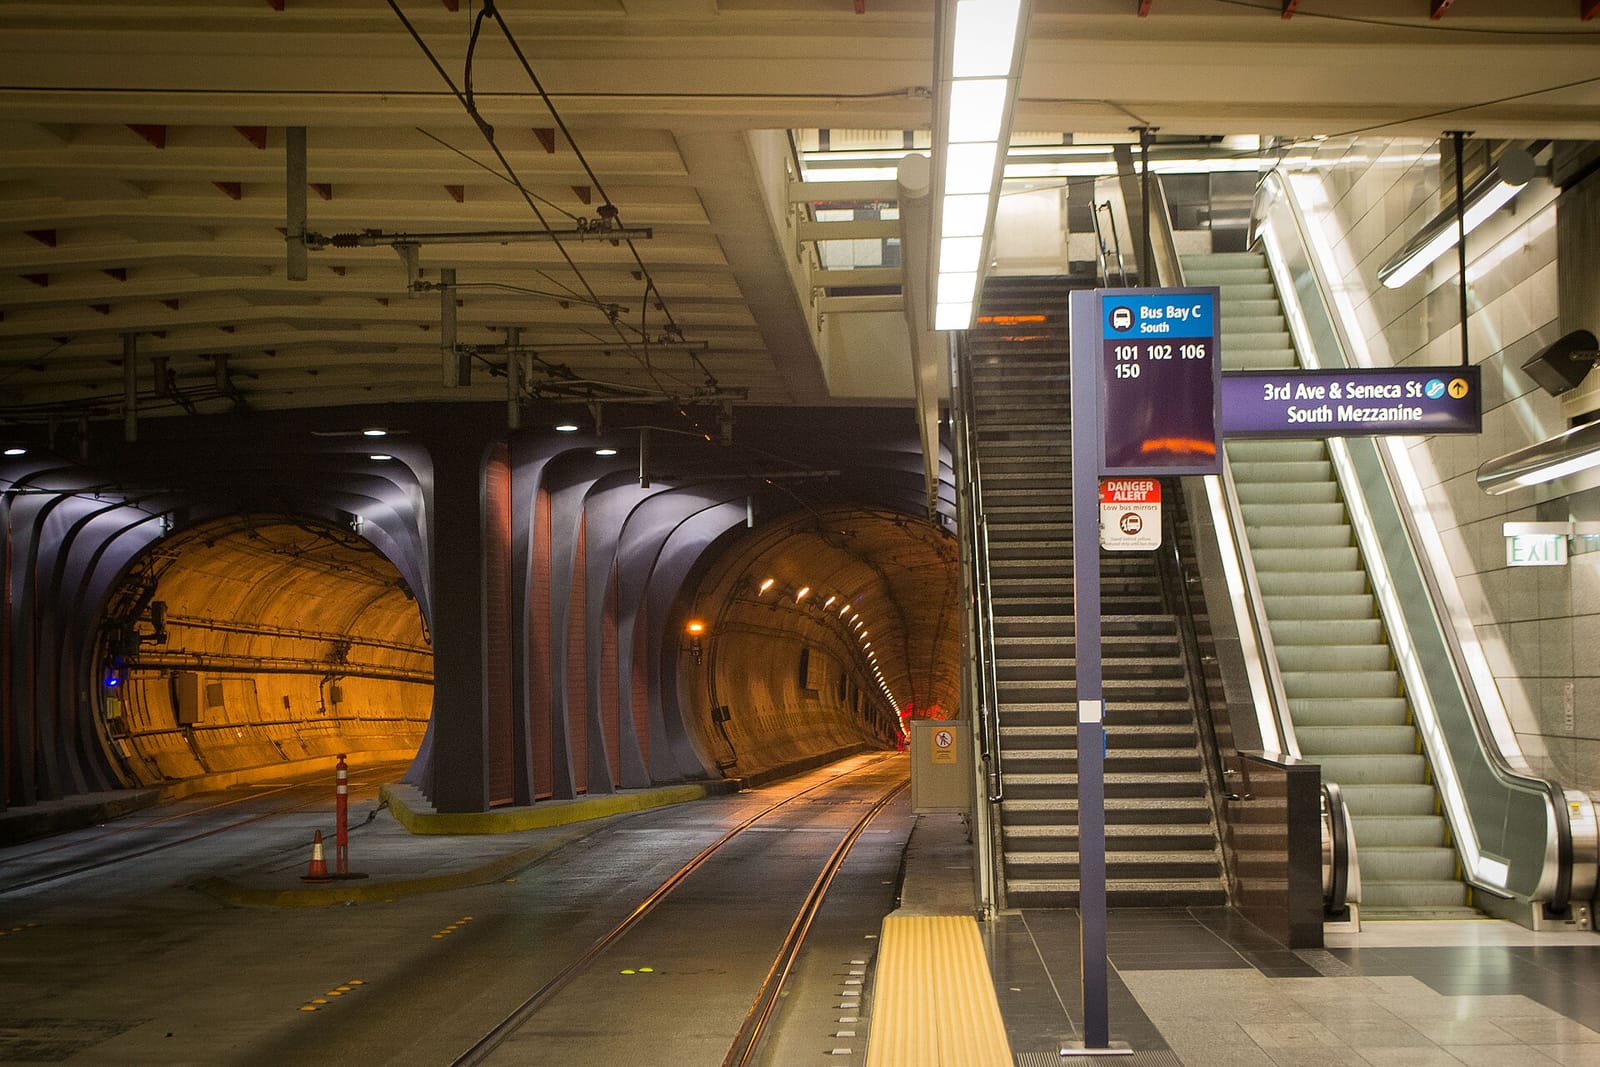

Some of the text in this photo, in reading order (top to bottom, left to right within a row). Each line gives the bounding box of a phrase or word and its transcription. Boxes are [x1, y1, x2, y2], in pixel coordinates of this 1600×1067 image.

[1140, 304, 1202, 321] Bus Bay C
[1140, 321, 1169, 333] South
[1114, 344, 1205, 360] 101 102 106
[1114, 363, 1141, 378] 150
[1263, 380, 1423, 401] 3rd Ave & Seneca St
[1287, 404, 1423, 423] South Mezzanine
[1107, 481, 1154, 491] DANGER
[1113, 491, 1148, 501] ALERT
[1512, 534, 1562, 562] EXIT
